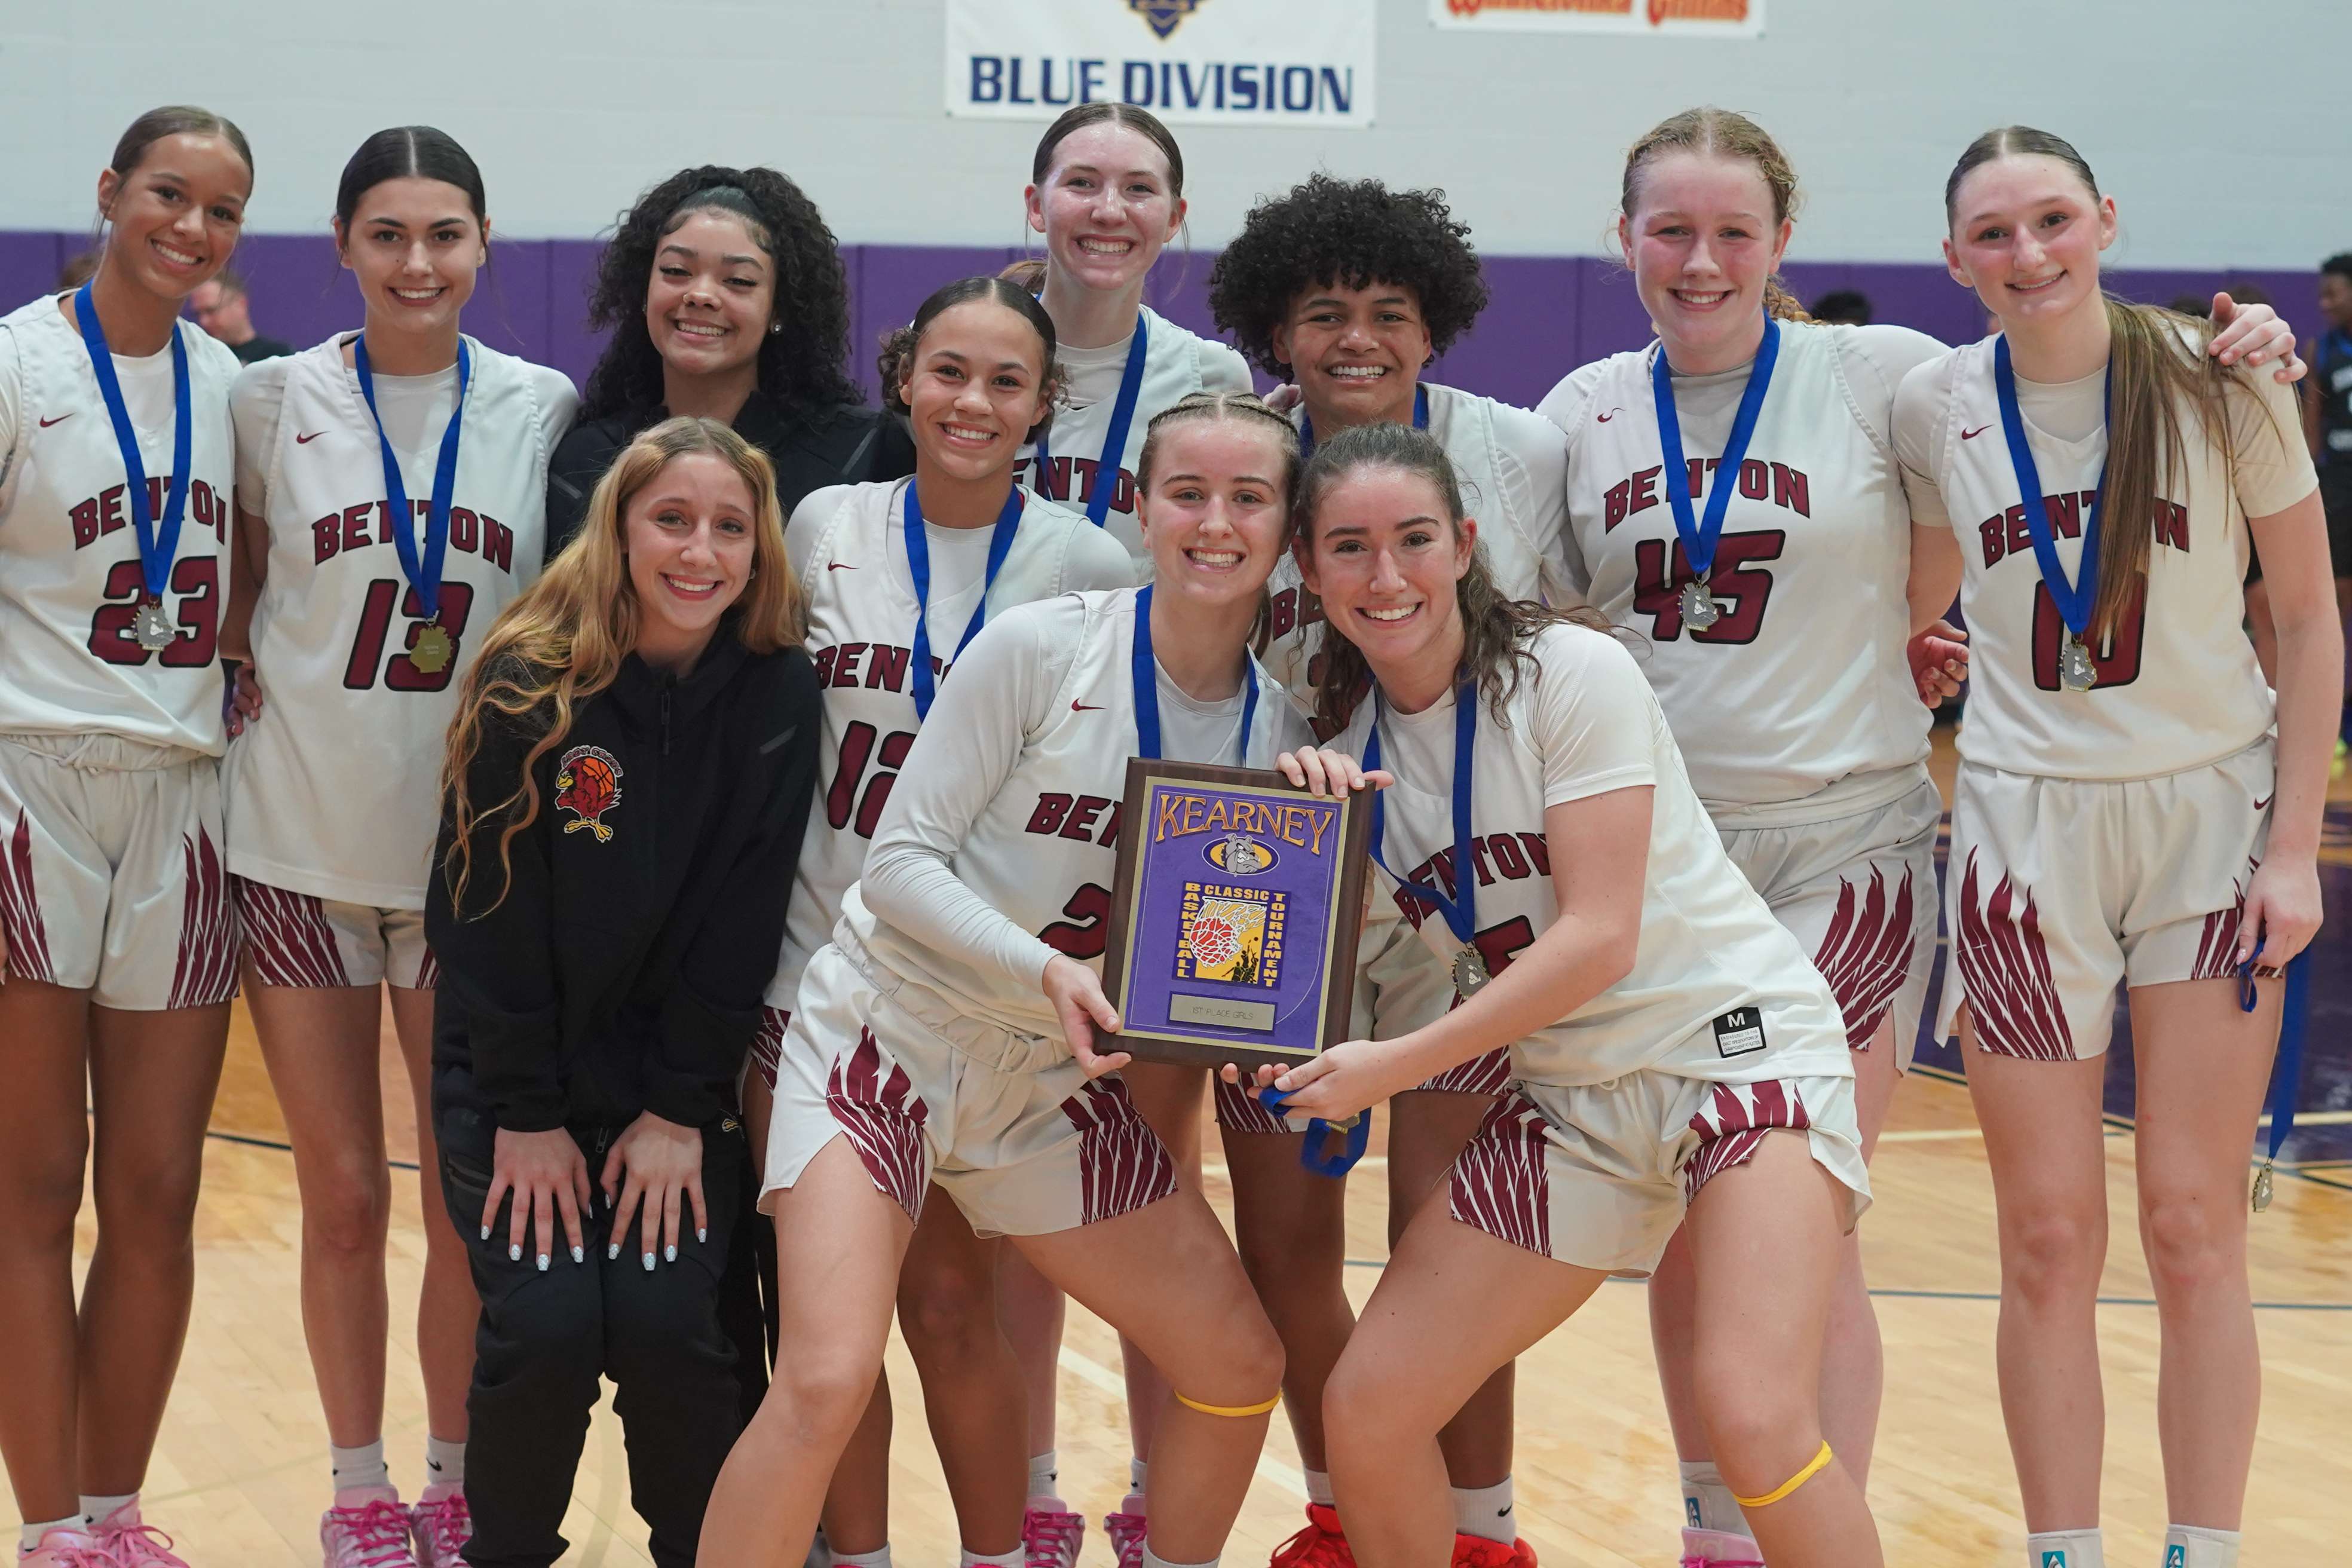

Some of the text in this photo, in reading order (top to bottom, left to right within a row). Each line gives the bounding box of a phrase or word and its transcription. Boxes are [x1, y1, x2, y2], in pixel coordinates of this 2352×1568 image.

[970, 57, 1353, 112] BLUE DIVISION
[87, 556, 219, 667] 23
[1633, 529, 1786, 644] 45
[343, 578, 474, 692] 13
[1156, 794, 1333, 855] KEARNEY
[1177, 883, 1200, 978] BASKETBALL
[1204, 885, 1270, 901] CLASSIC
[1263, 893, 1286, 987] TOURNAMENT
[1727, 1012, 1745, 1028] M
